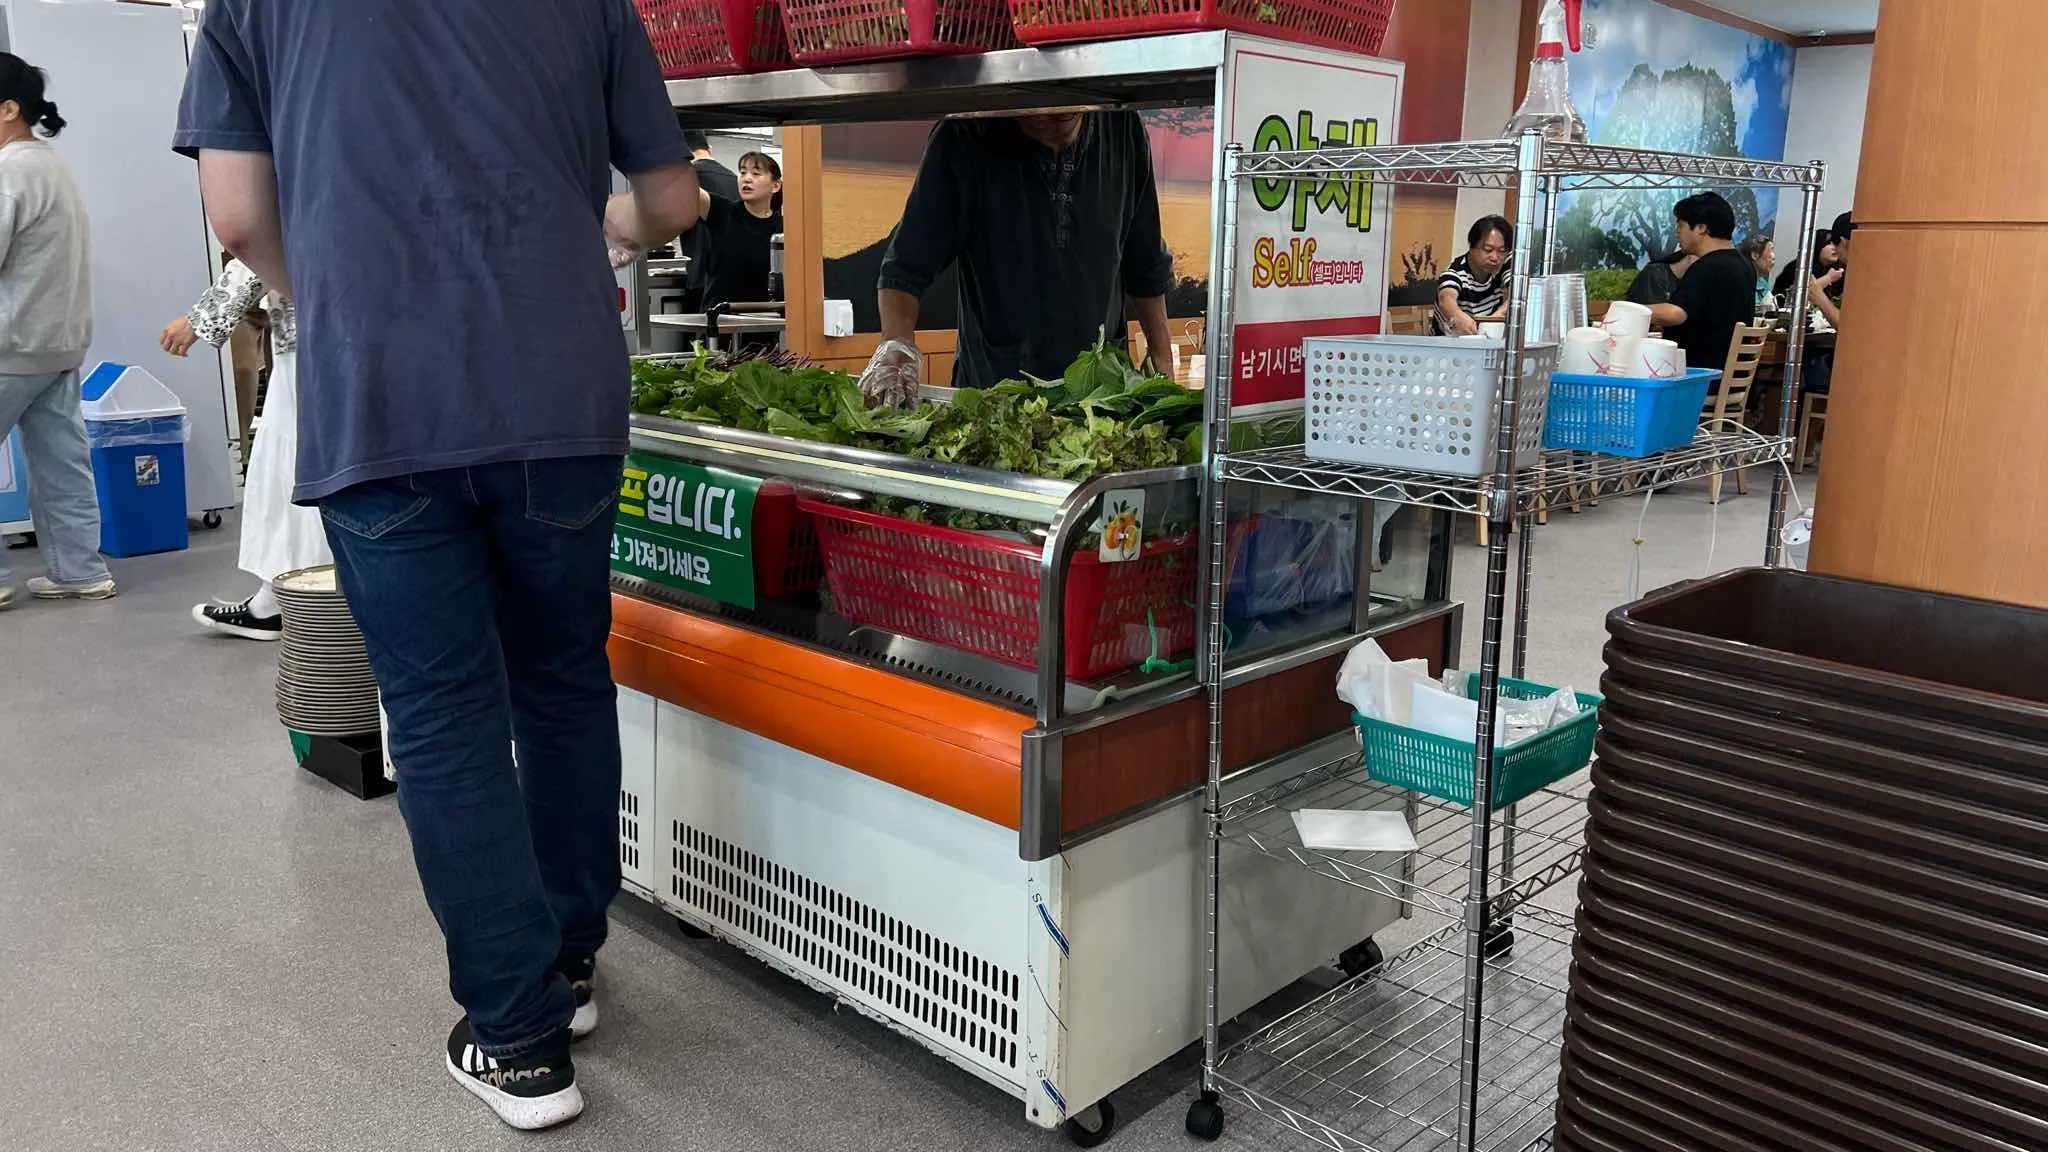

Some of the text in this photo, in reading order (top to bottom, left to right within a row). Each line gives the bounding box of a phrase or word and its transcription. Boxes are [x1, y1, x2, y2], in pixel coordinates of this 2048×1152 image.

[1251, 110, 1378, 232] 야채
[1253, 237, 1317, 287] Self
[624, 537, 711, 585] 가져가세요
